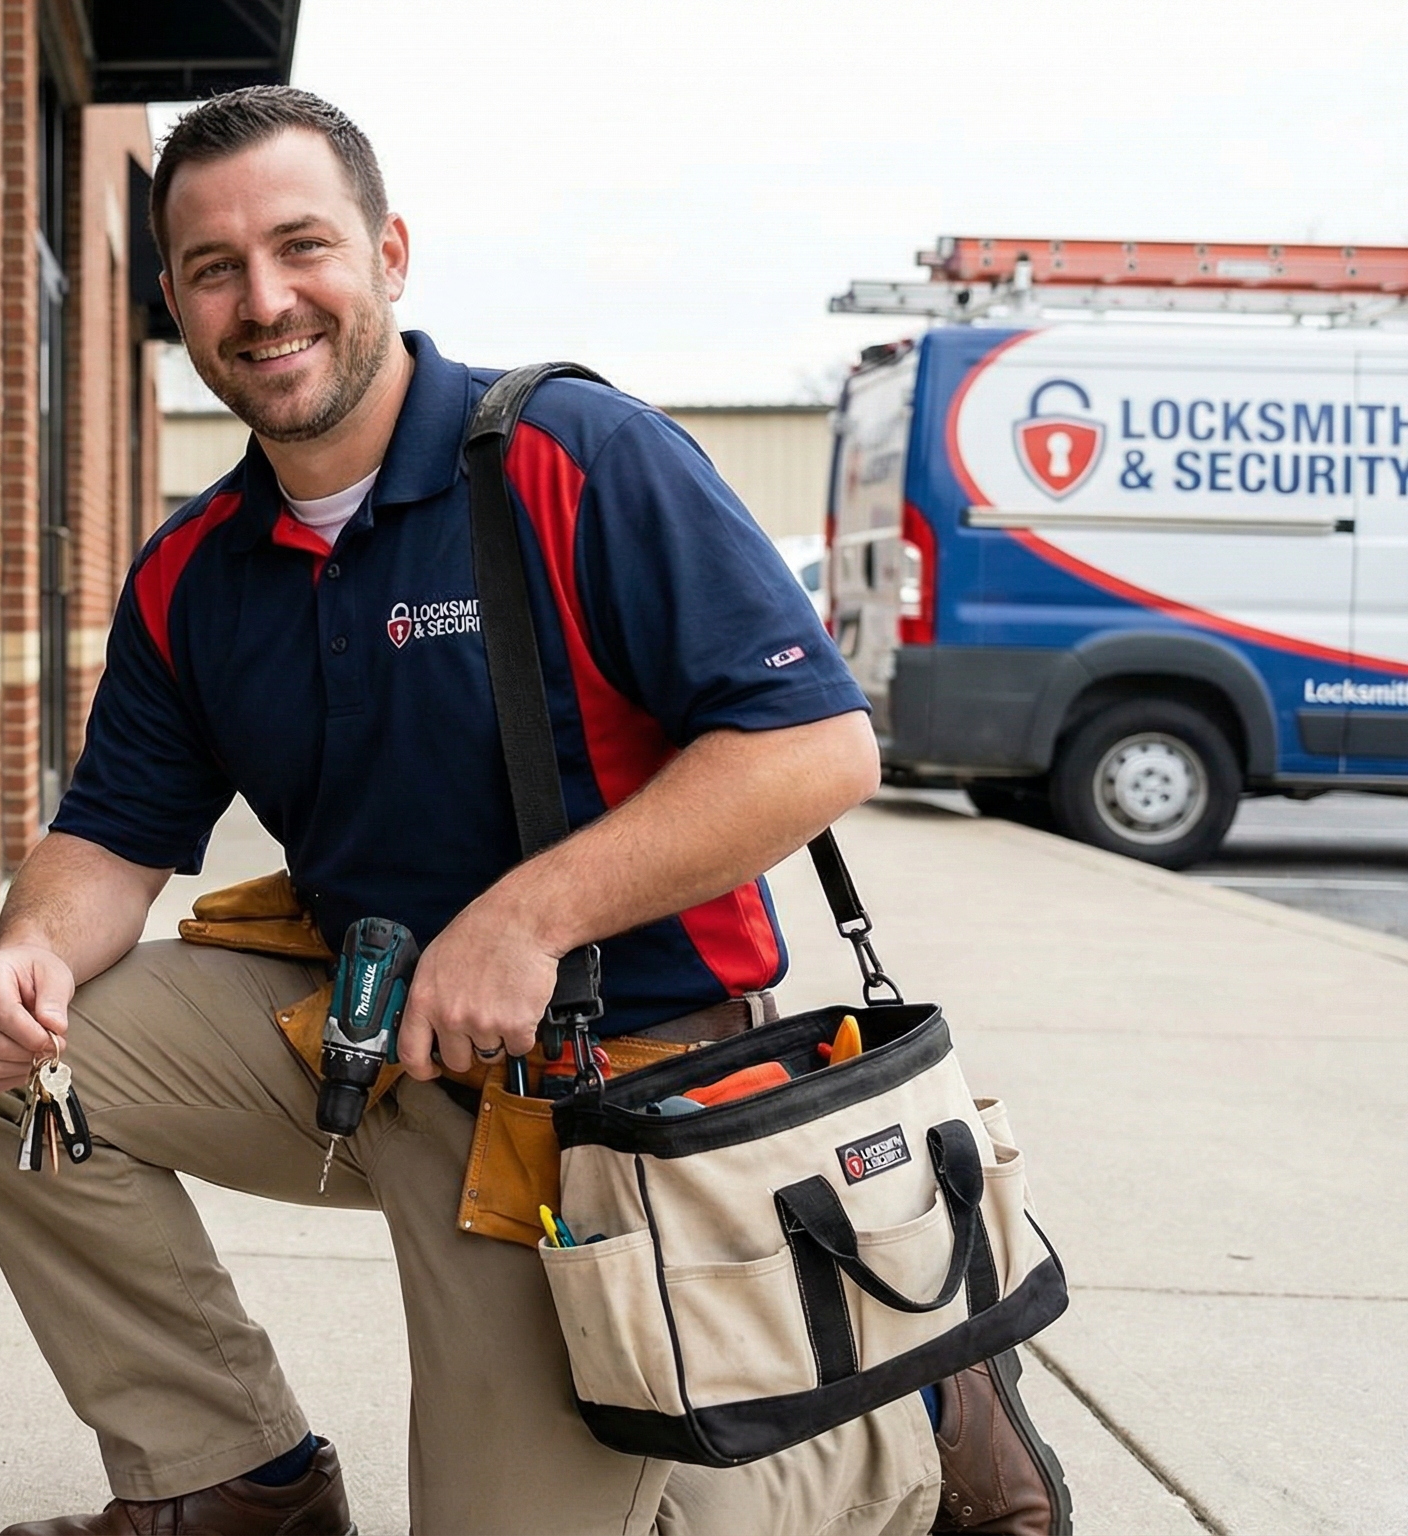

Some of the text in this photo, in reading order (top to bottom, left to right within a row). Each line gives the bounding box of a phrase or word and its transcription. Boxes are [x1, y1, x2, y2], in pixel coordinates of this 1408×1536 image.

[1121, 398, 1408, 447] LOCKSMITH
[1120, 449, 1408, 496] & SECURITY
[413, 622, 425, 639] &
